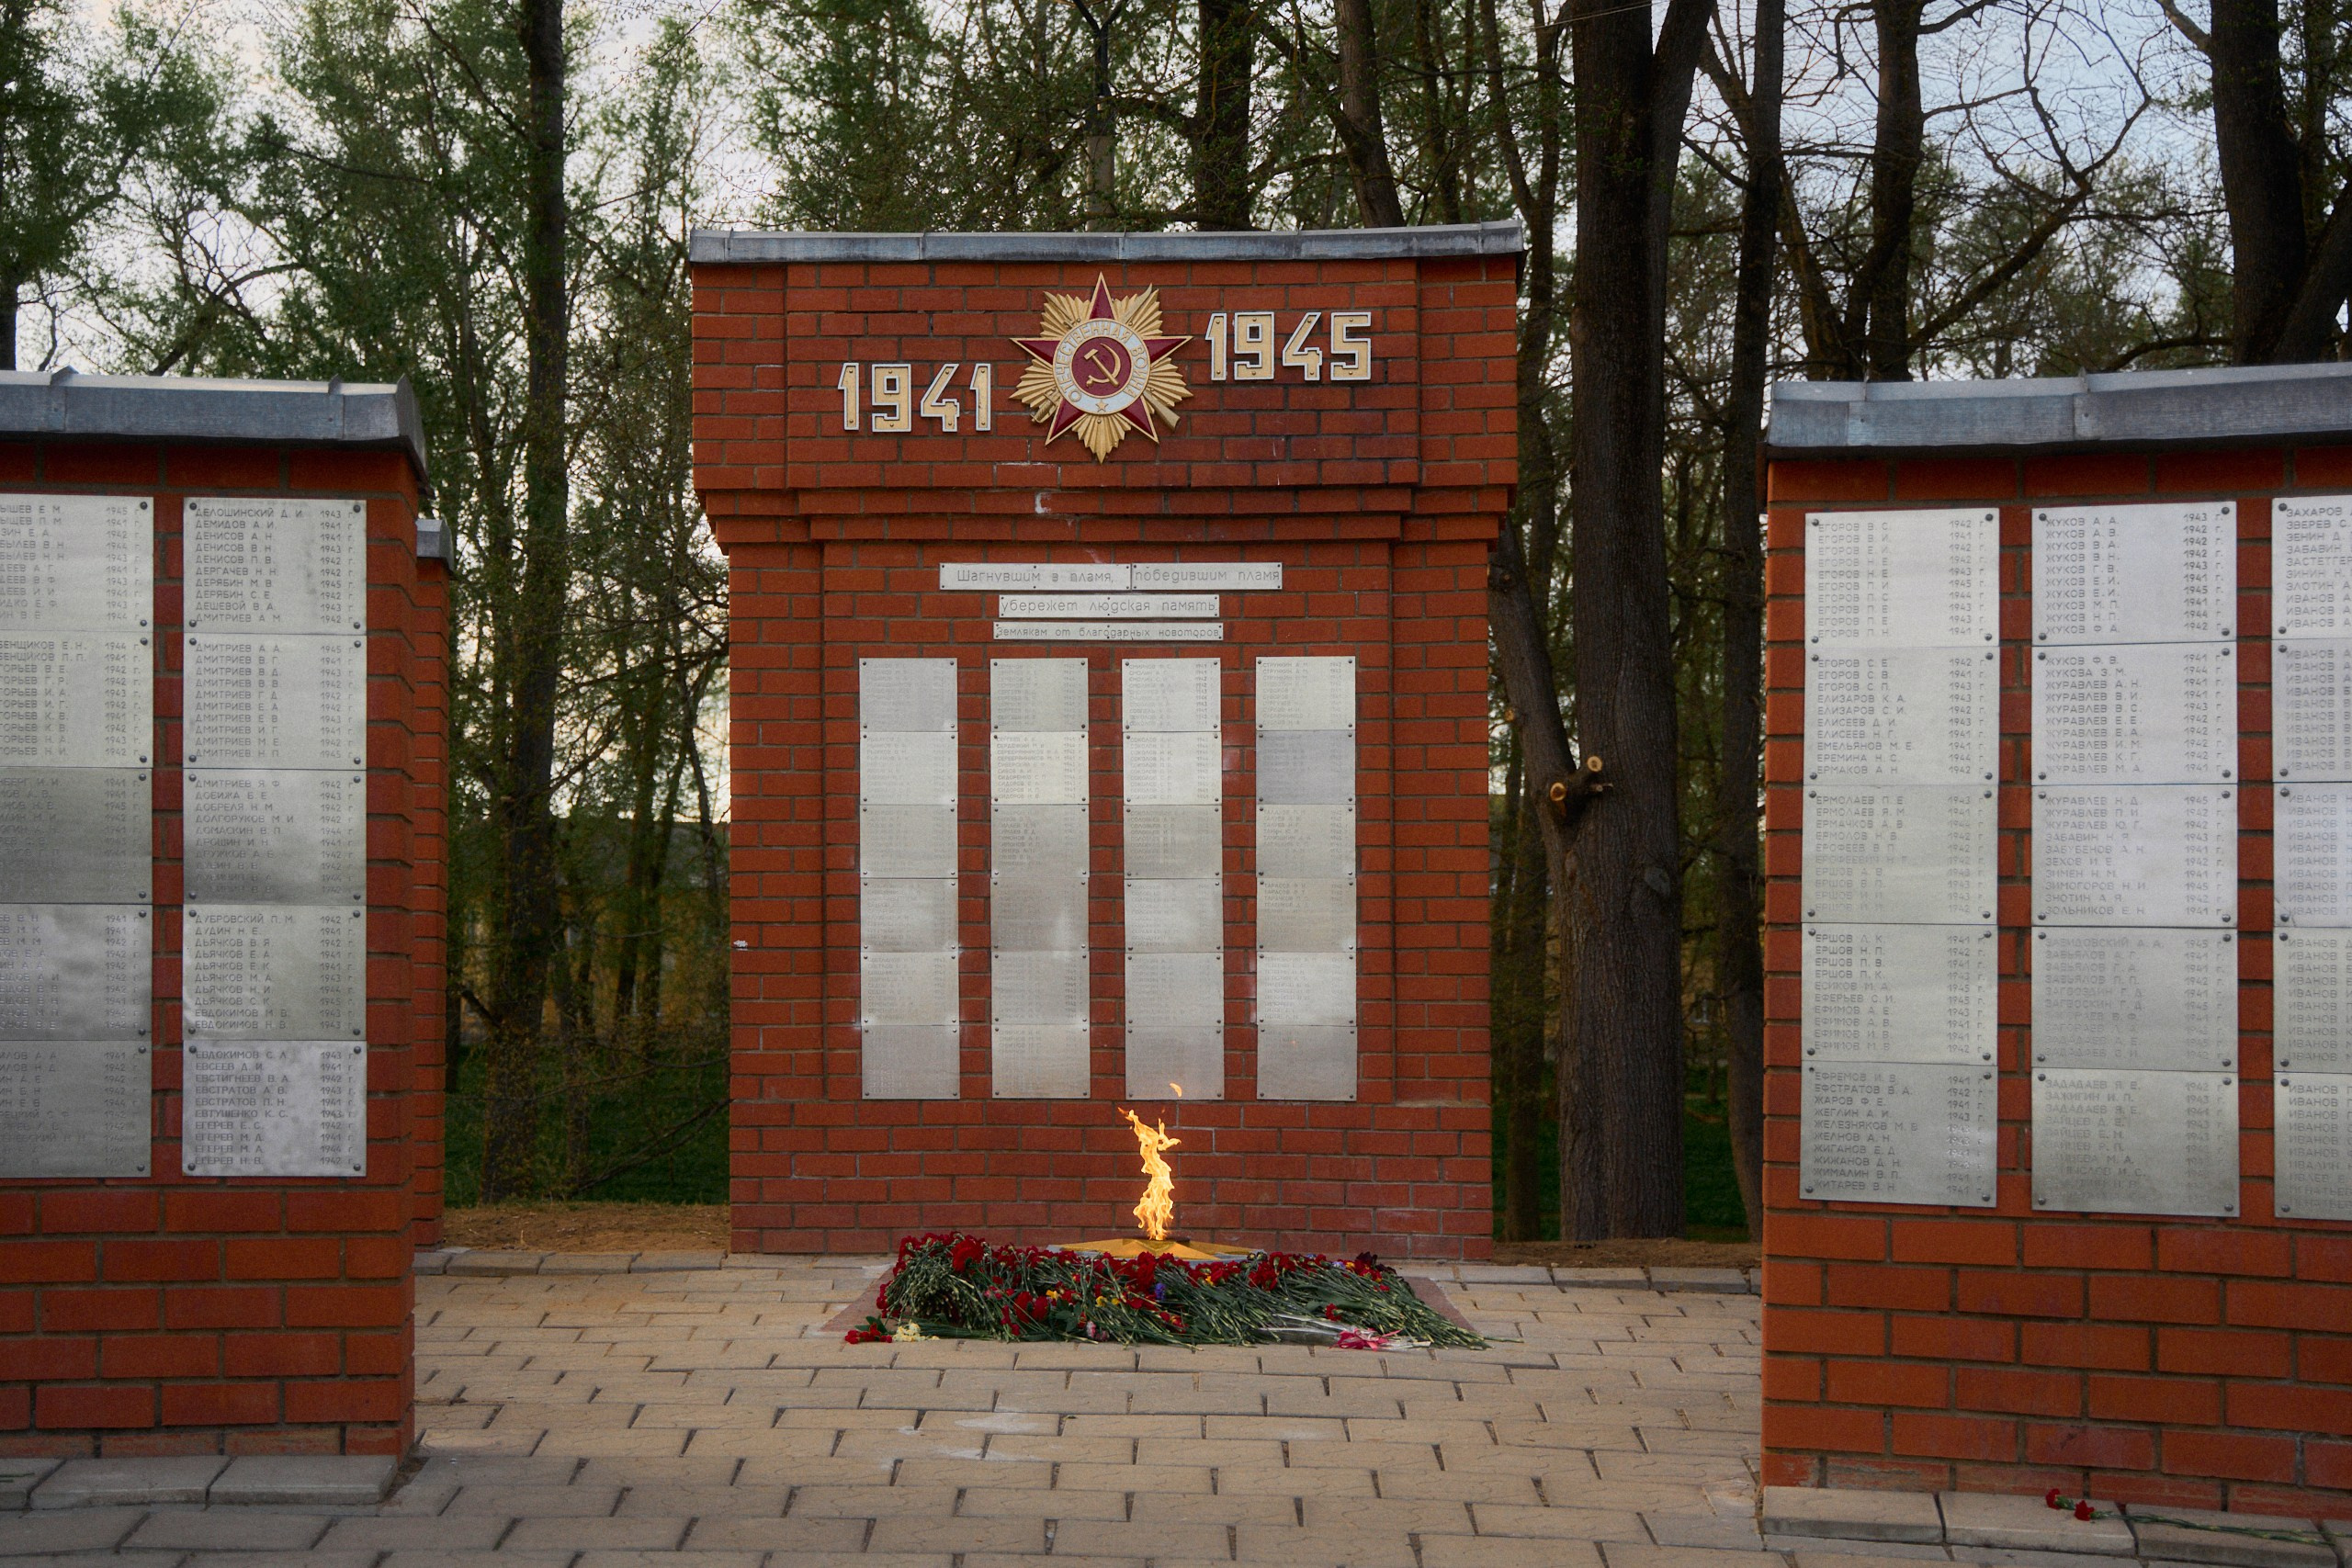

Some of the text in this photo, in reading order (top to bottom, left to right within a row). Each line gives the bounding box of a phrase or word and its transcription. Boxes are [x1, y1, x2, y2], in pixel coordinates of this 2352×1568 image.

[1205, 311, 1372, 381] 1945
[1057, 321, 1133, 402] ОТЕЧЕСТВЕННАЯ
[838, 363, 991, 433] 1941
[2286, 508, 2343, 516] ЗАХАРОВ
[1818, 524, 1860, 532] ЕГОРОВ
[2286, 521, 2331, 529] ЗВЕРЕВ
[196, 532, 244, 540] ДЕНИСОВ
[2286, 545, 2342, 553] ЗАБАВИН
[957, 570, 1041, 582] Шагнувшим
[1135, 570, 1227, 583] победившим
[1238, 570, 1280, 581] пламя
[1818, 570, 1860, 579] ЕГОРОВ
[2286, 582, 2335, 591] ЗЛОТИН
[2286, 594, 2335, 603] ИВАНОВ
[1001, 600, 1078, 613] убережет
[1090, 599, 1150, 614] людская
[2286, 606, 2335, 615] ИВАНОВ
[1056, 628, 1071, 637] от
[1079, 627, 1150, 638] благодарных
[2046, 657, 2085, 665] ЖУКОВ
[2046, 669, 2093, 677] ЖУКОВА
[2046, 681, 2108, 689] ЖУРАВЛЕВ
[1818, 694, 1874, 703] ЕЛИЗАРОВ
[2046, 693, 2108, 701] ЖУРАВЛЕВ
[1818, 706, 1874, 715] ЕЛИЗАРОВ
[1818, 718, 1866, 727] ЕЛИСЕЕВ
[1818, 730, 1865, 739] ЕЛИСЕЕВ
[196, 915, 264, 923] ДУБРОВСКИЙ
[2289, 1086, 2338, 1094] ИВАНОВ
